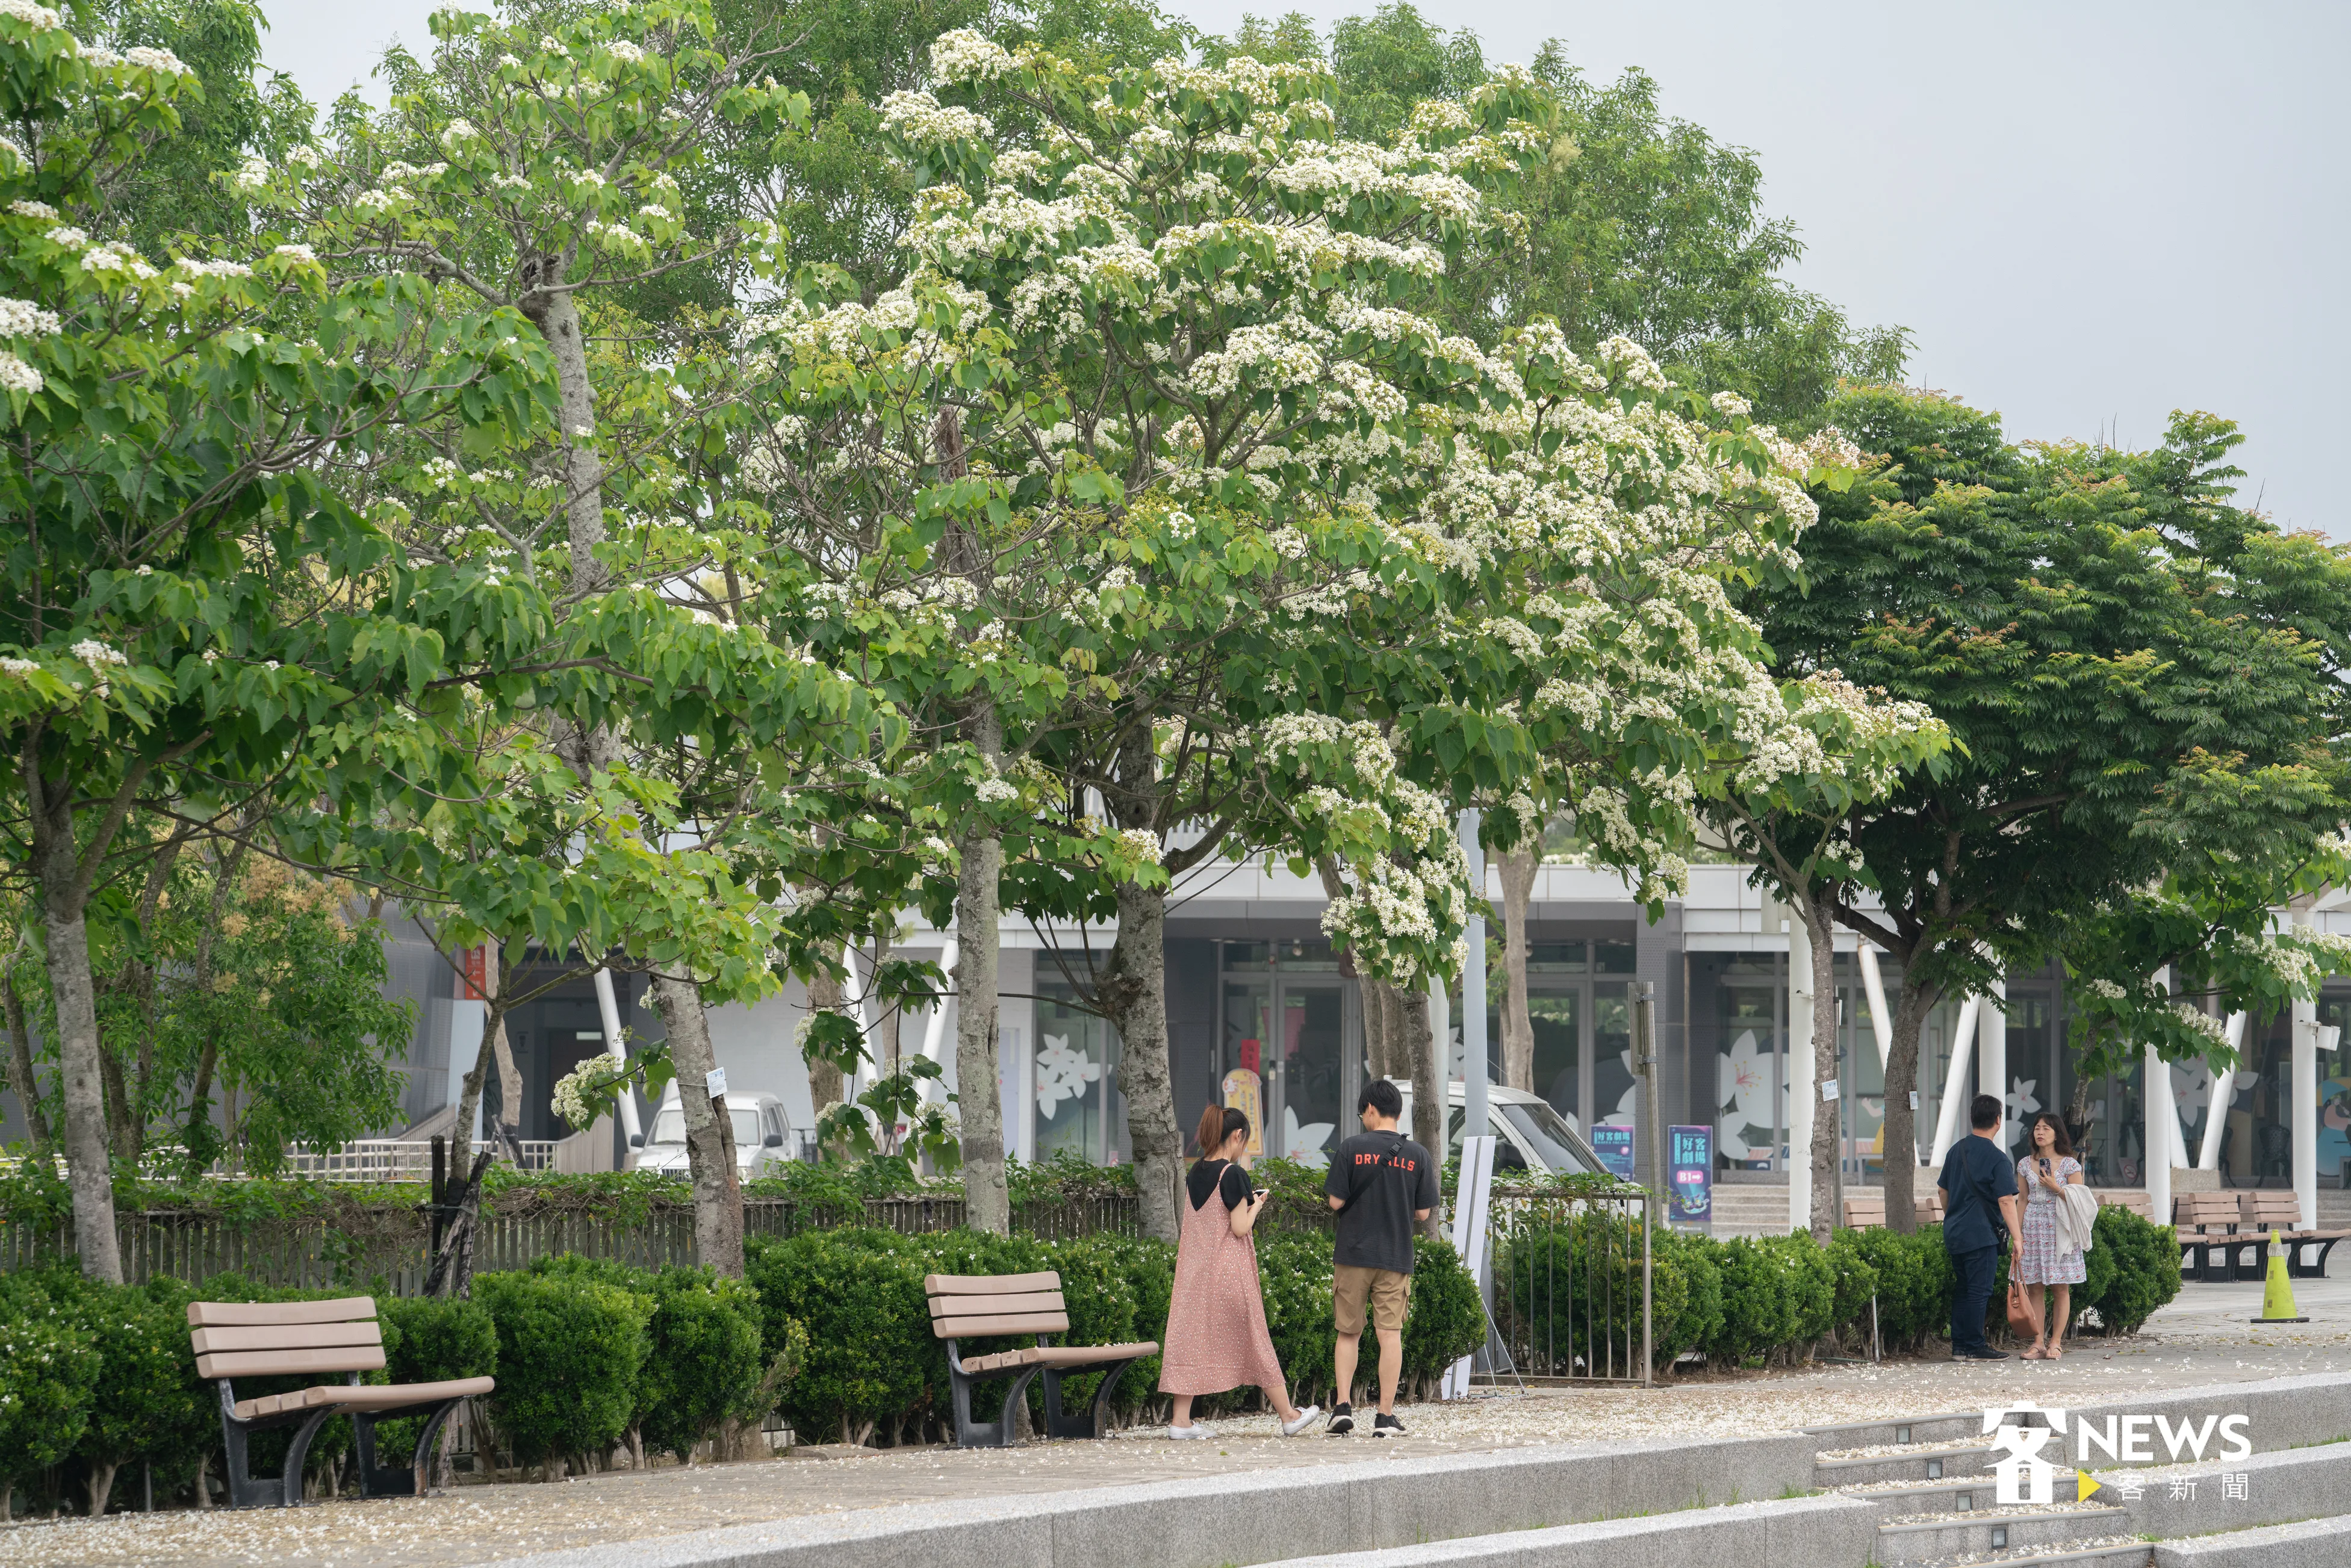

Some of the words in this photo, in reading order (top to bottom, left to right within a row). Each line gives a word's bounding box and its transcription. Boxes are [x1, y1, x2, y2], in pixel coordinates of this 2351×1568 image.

[1682, 1137, 1706, 1151] 好客
[1355, 1154, 1380, 1165] DRY
[1682, 1151, 1706, 1165] 劇場
[1680, 1172, 1692, 1182] B1
